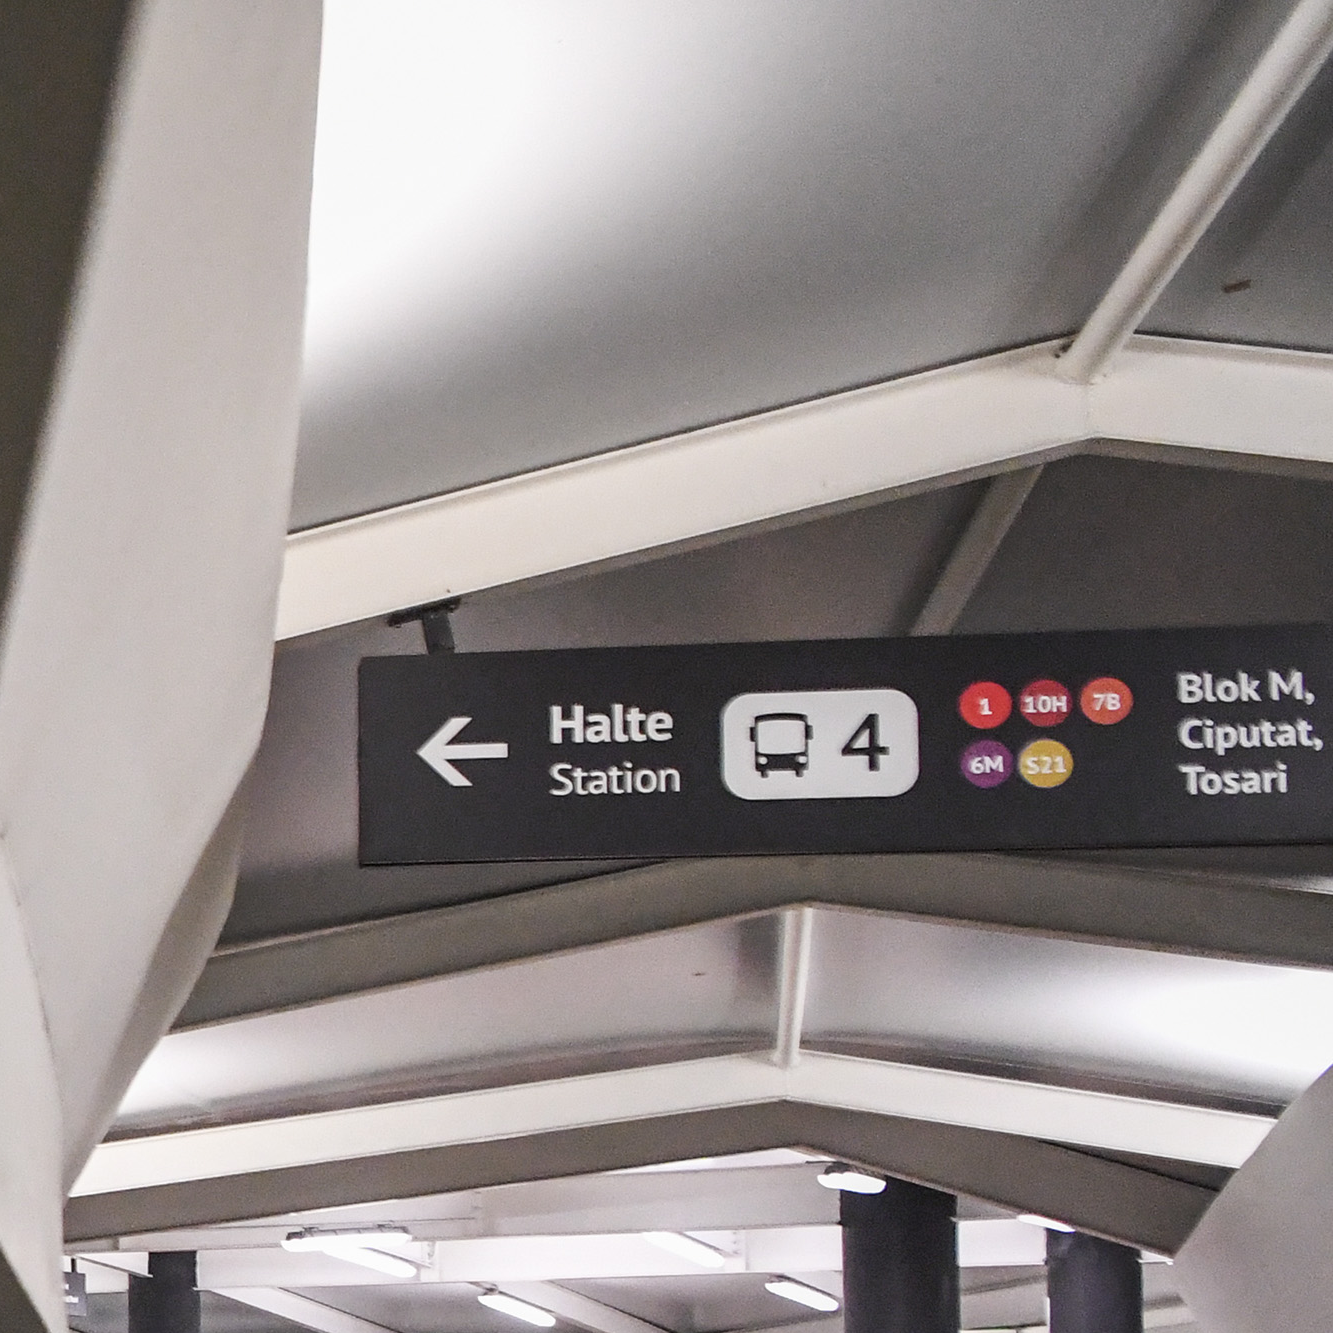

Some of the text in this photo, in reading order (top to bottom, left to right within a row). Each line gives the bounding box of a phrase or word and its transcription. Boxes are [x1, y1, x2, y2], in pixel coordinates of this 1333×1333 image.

[978, 691, 1121, 715] 1 10H 7B
[1176, 668, 1316, 705] Blok M,
[549, 703, 674, 744] Halte
[1177, 717, 1324, 756] Ciputat,
[841, 712, 891, 772] 4
[548, 760, 681, 796] Station
[969, 754, 1067, 775] 6M S21
[1177, 761, 1289, 795] Tosari
